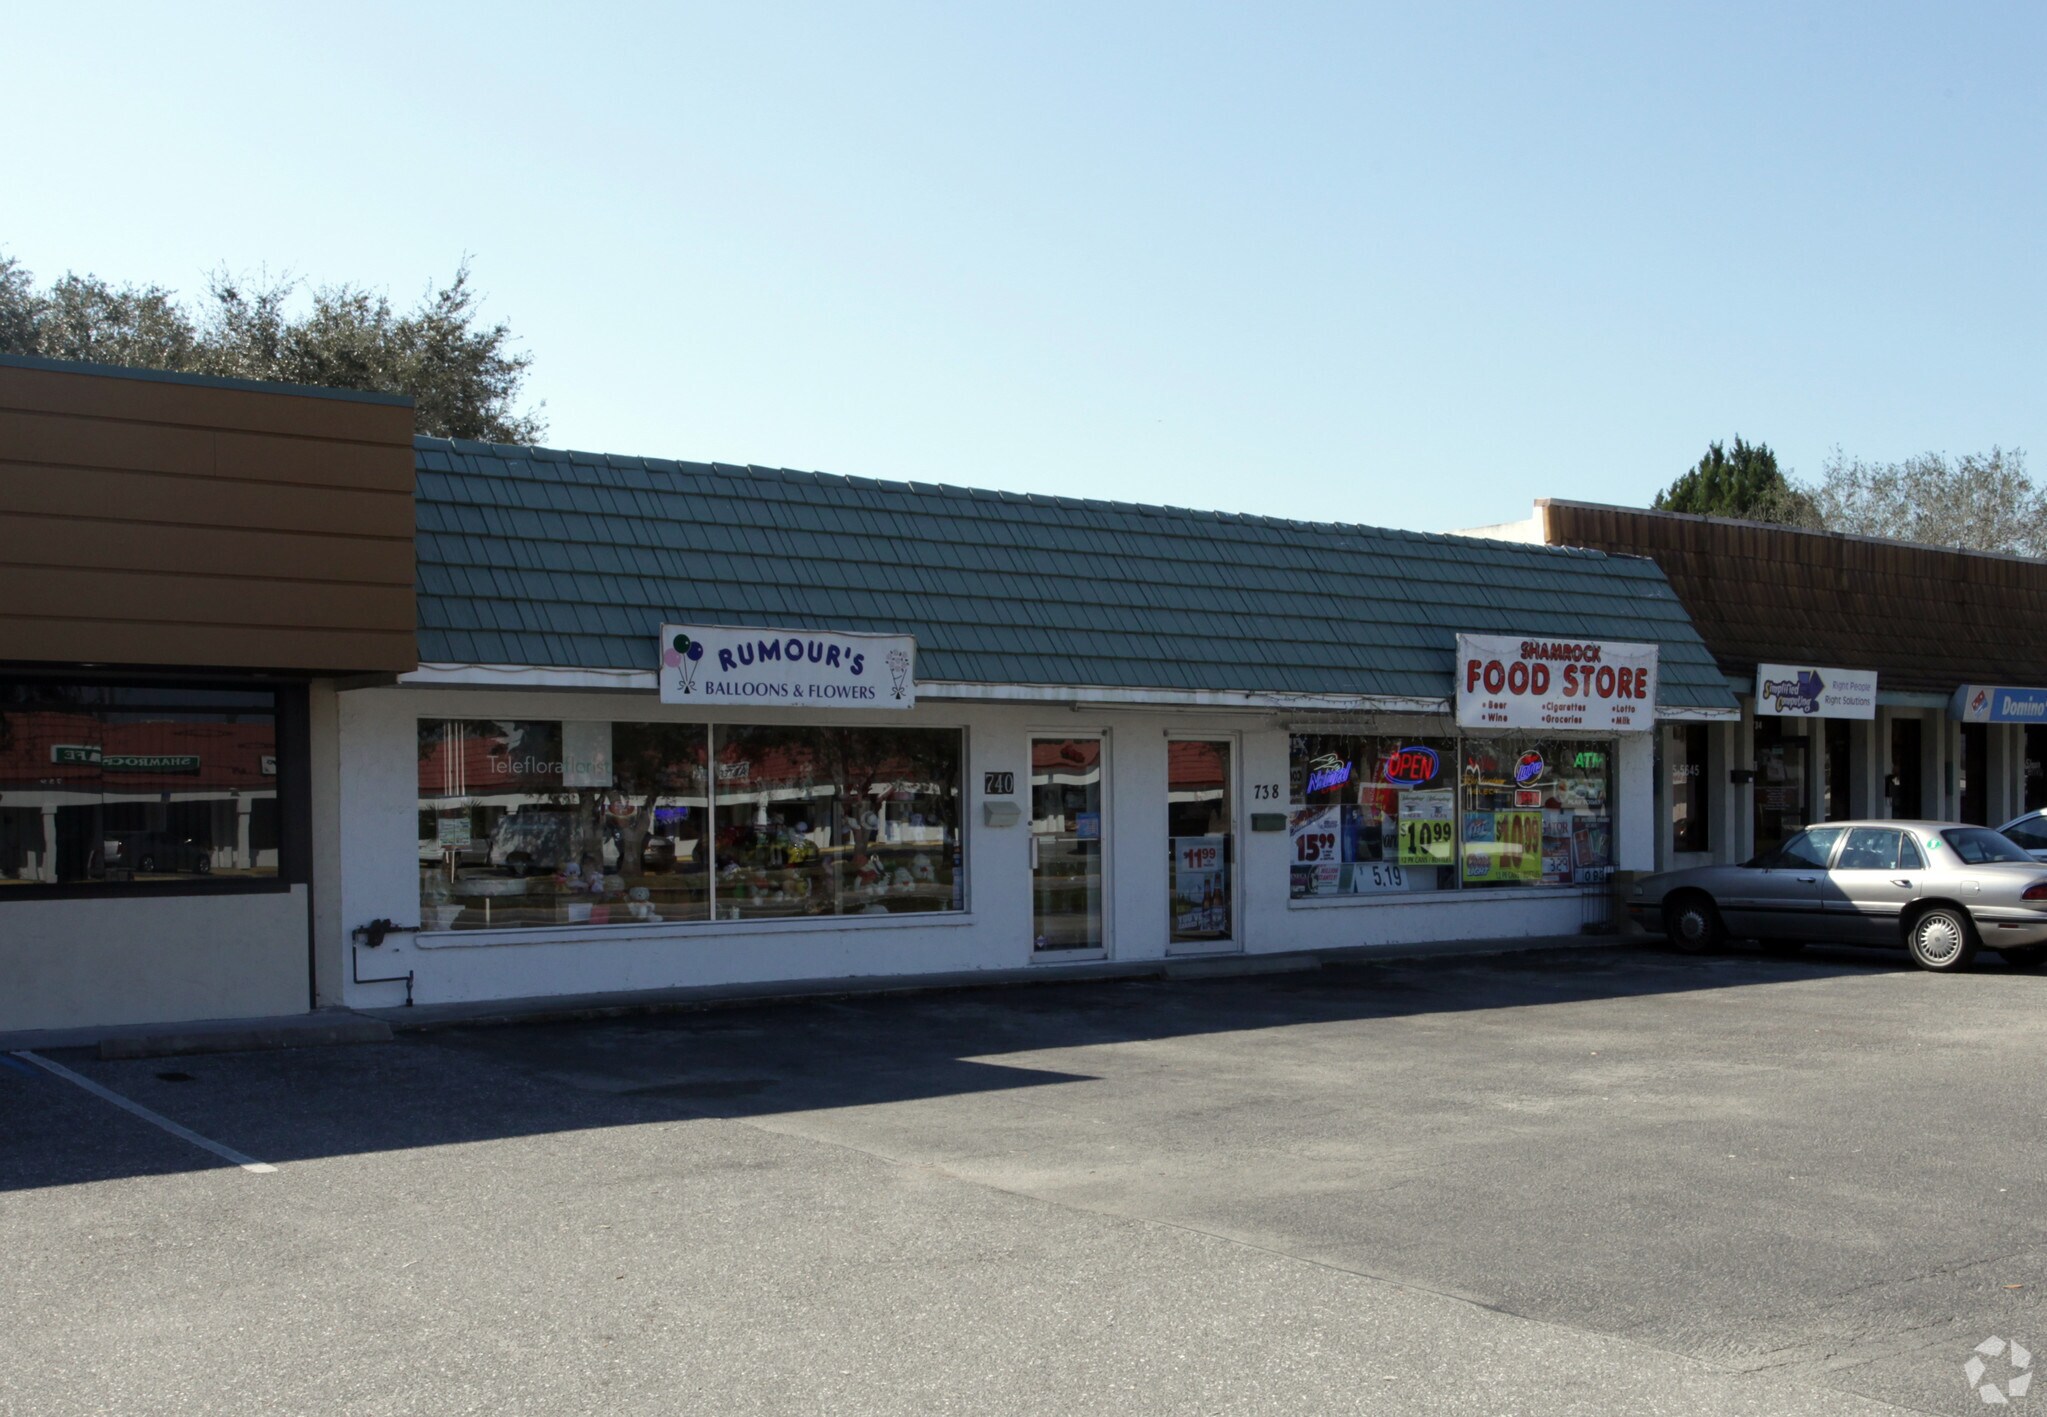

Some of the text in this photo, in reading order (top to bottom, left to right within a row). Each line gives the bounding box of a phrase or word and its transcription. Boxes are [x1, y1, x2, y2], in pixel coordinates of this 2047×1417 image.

[718, 638, 866, 676] RUMOUR'S
[1520, 641, 1602, 663] SHAMROCK
[1467, 659, 1648, 700] FOOD STORE
[1832, 681, 1871, 692] Right People
[705, 681, 876, 700] BALLOONS & FLOWERS
[1764, 680, 1800, 698] Simplified
[1488, 700, 1508, 710] Beer
[1546, 702, 1587, 714] Cigarettes
[1775, 695, 1813, 713] Computing
[1825, 695, 1871, 706] Right Solutions
[1615, 705, 1636, 714] Lotto
[1488, 713, 1508, 723] Wine
[1546, 714, 1583, 725] Groceries
[1615, 716, 1631, 725] Milk
[1387, 752, 1434, 780] OPEN
[1574, 752, 1606, 768] ATM
[985, 772, 1014, 794] 740
[1254, 784, 1280, 800] 738
[1372, 865, 1402, 887] 5.19
